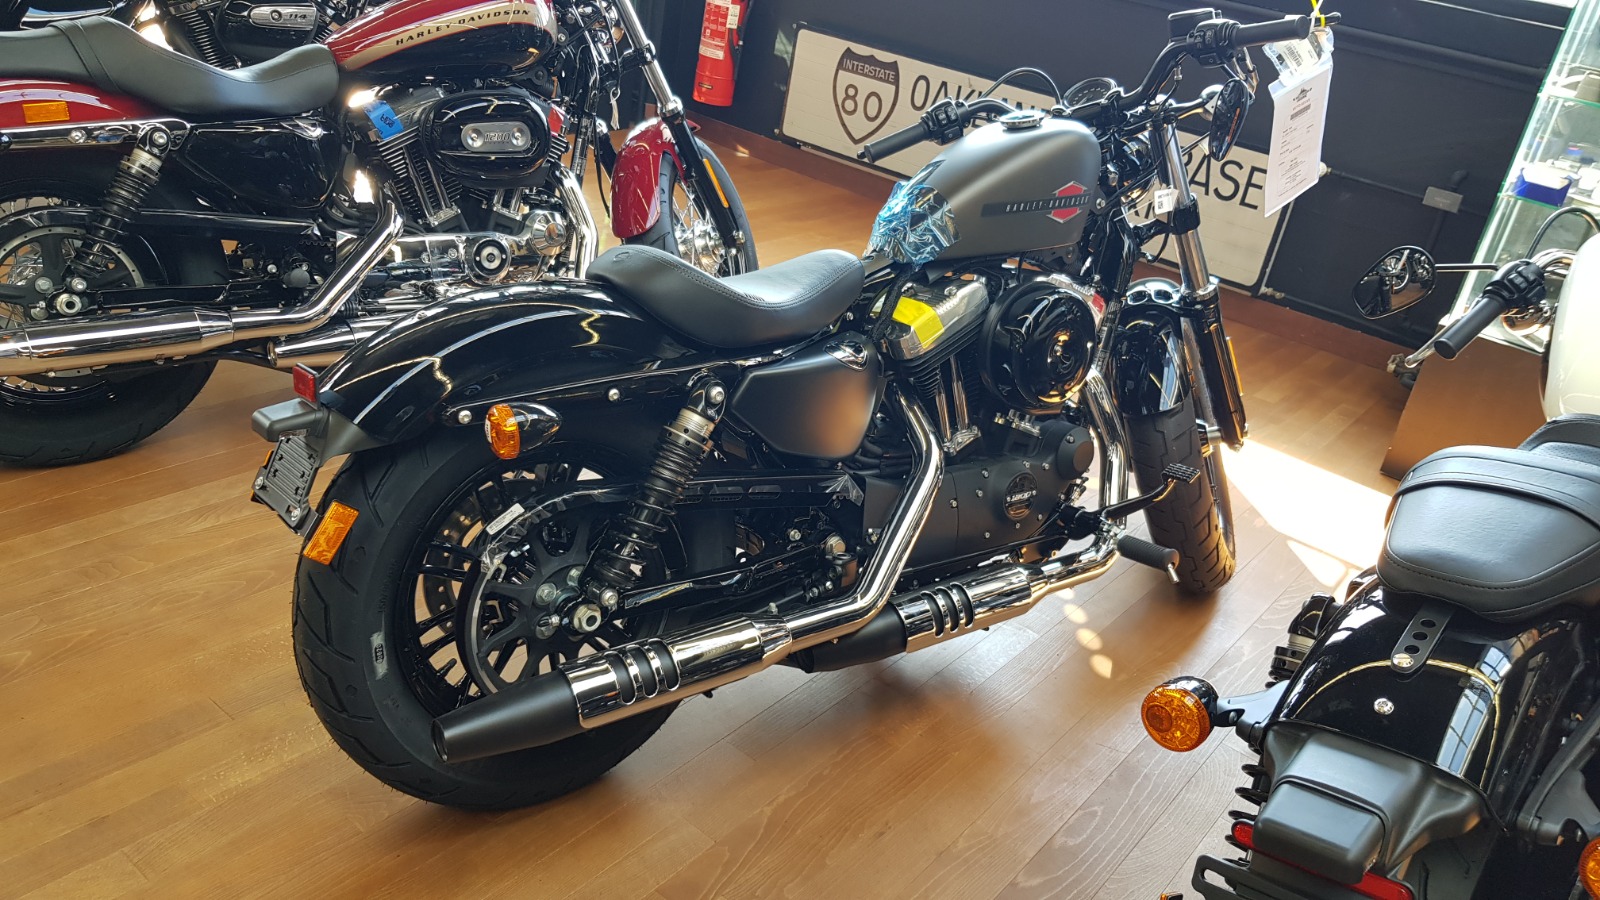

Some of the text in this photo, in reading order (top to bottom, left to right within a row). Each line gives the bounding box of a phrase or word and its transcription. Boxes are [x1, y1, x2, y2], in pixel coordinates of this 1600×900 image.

[395, 9, 531, 46] HARLEY-DAVIDSON
[842, 58, 896, 82] INTERSTATE
[841, 84, 883, 123] 80
[484, 132, 511, 142] 1200
[1005, 196, 1089, 213] HARLEY-DAVIDSON
